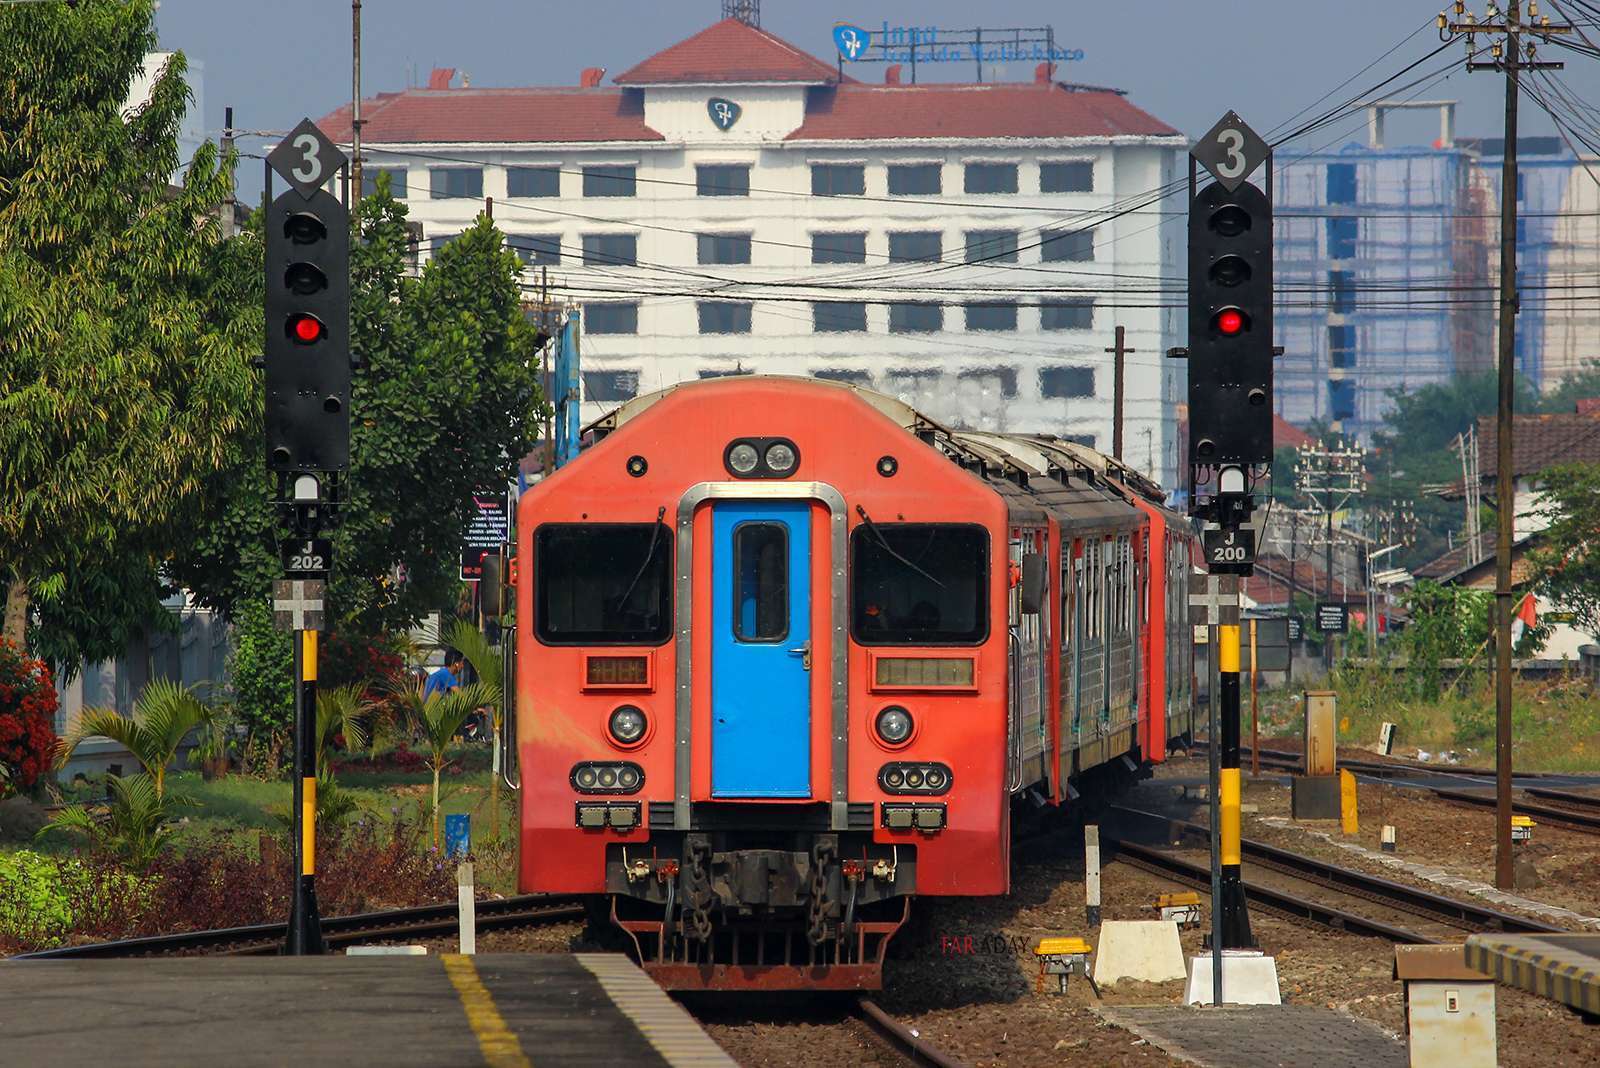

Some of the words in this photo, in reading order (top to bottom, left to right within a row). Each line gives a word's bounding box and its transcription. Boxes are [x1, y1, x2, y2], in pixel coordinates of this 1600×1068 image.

[292, 134, 322, 183] 3
[1216, 128, 1246, 178] 3
[1224, 532, 1234, 545] J
[302, 541, 313, 554] J
[1214, 547, 1246, 561] 200
[291, 556, 323, 569] 202
